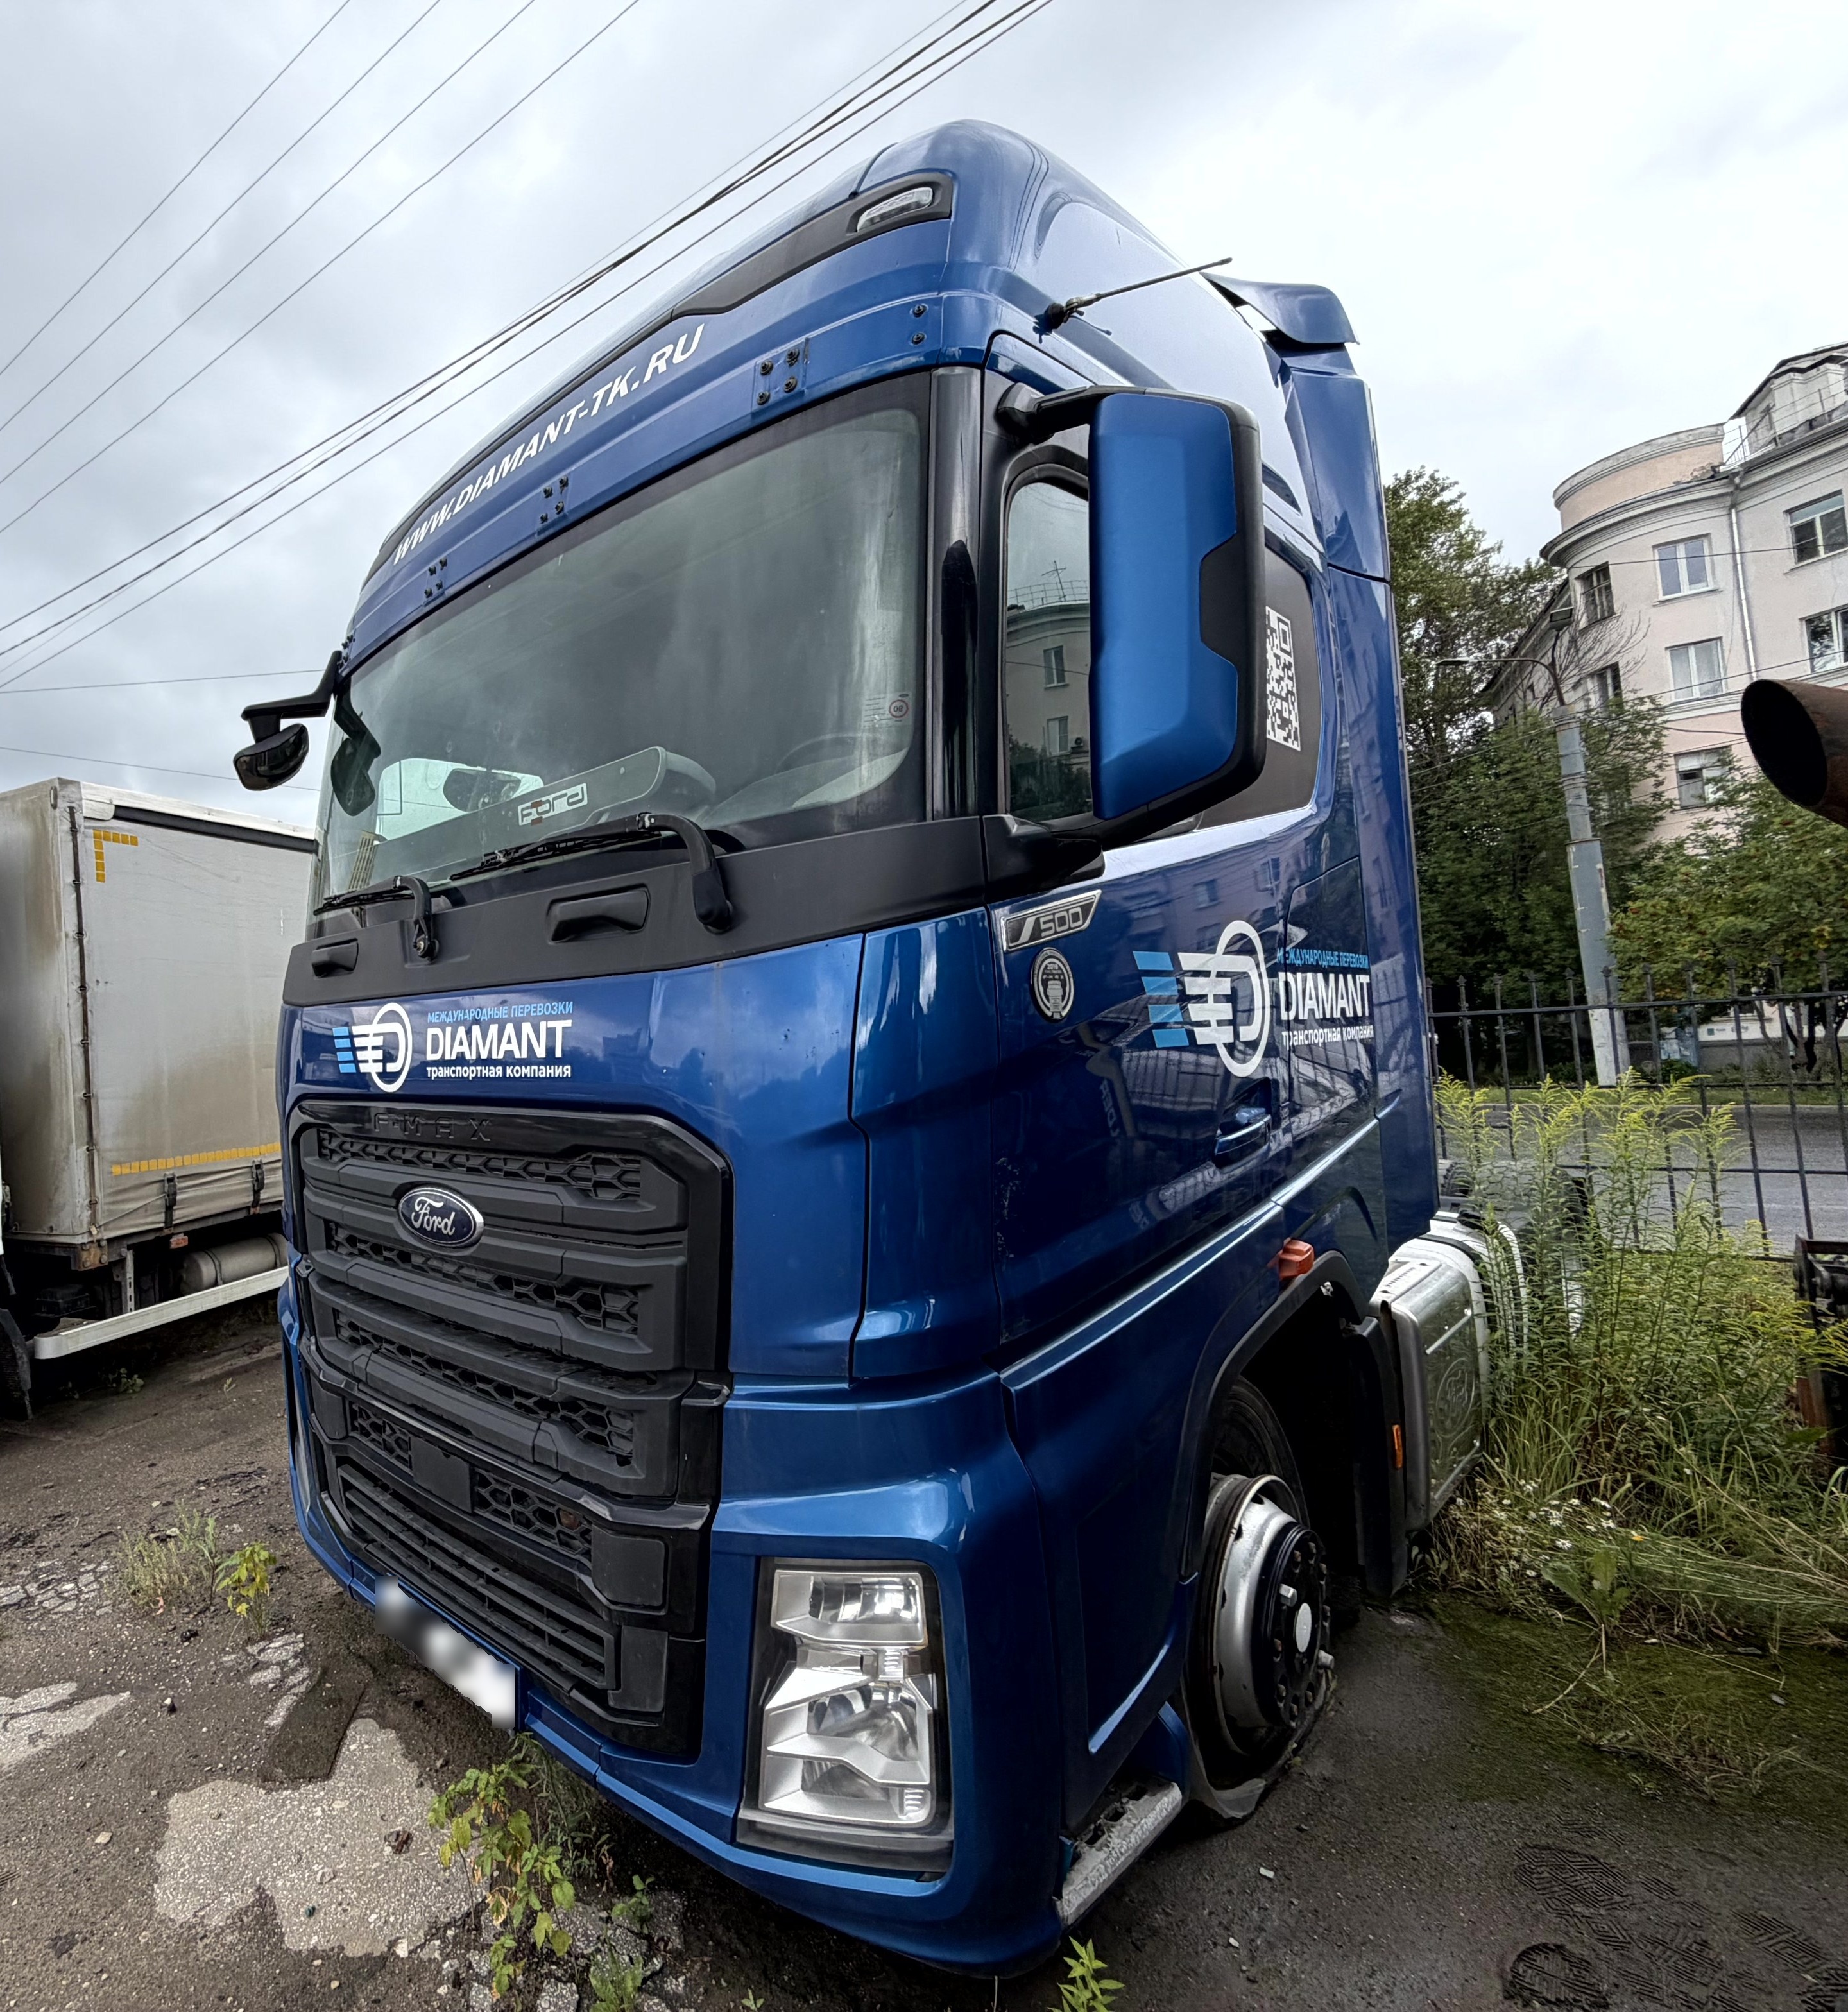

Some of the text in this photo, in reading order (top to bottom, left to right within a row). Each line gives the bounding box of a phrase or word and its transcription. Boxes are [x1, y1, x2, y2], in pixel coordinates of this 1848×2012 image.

[393, 323, 705, 565] WWW.DIAMANT-TK.RU
[1040, 907, 1083, 937] 500
[427, 1001, 573, 1022] МЕЖДУНАРОДНЫЕ ПЕРЕВОЗКИ
[1278, 971, 1370, 1021] DIAMANT
[426, 1019, 572, 1061] DIAMANT
[427, 1065, 572, 1080] транспортная компания
[411, 1197, 455, 1236] Ford
